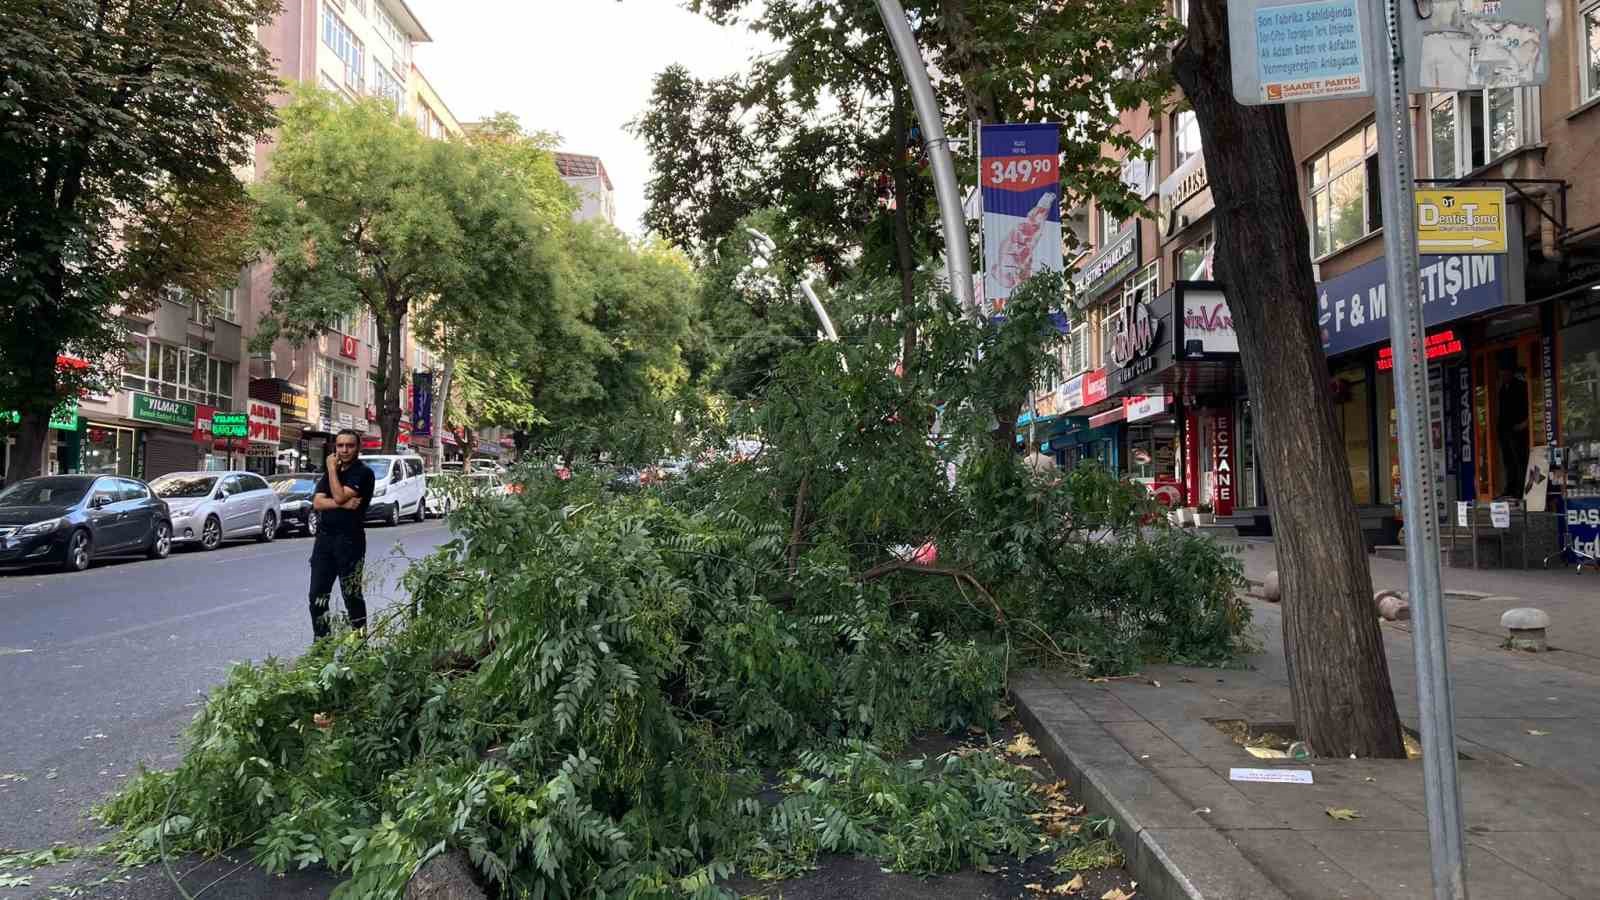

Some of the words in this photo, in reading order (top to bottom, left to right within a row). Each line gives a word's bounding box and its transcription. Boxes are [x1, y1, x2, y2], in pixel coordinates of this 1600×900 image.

[1283, 80, 1321, 92] SAADET
[1335, 299, 1345, 332] F
[1350, 293, 1365, 327] &
[1369, 283, 1387, 321] M
[1459, 366, 1472, 463] BAŞARI
[1217, 417, 1231, 500] ECZANE
